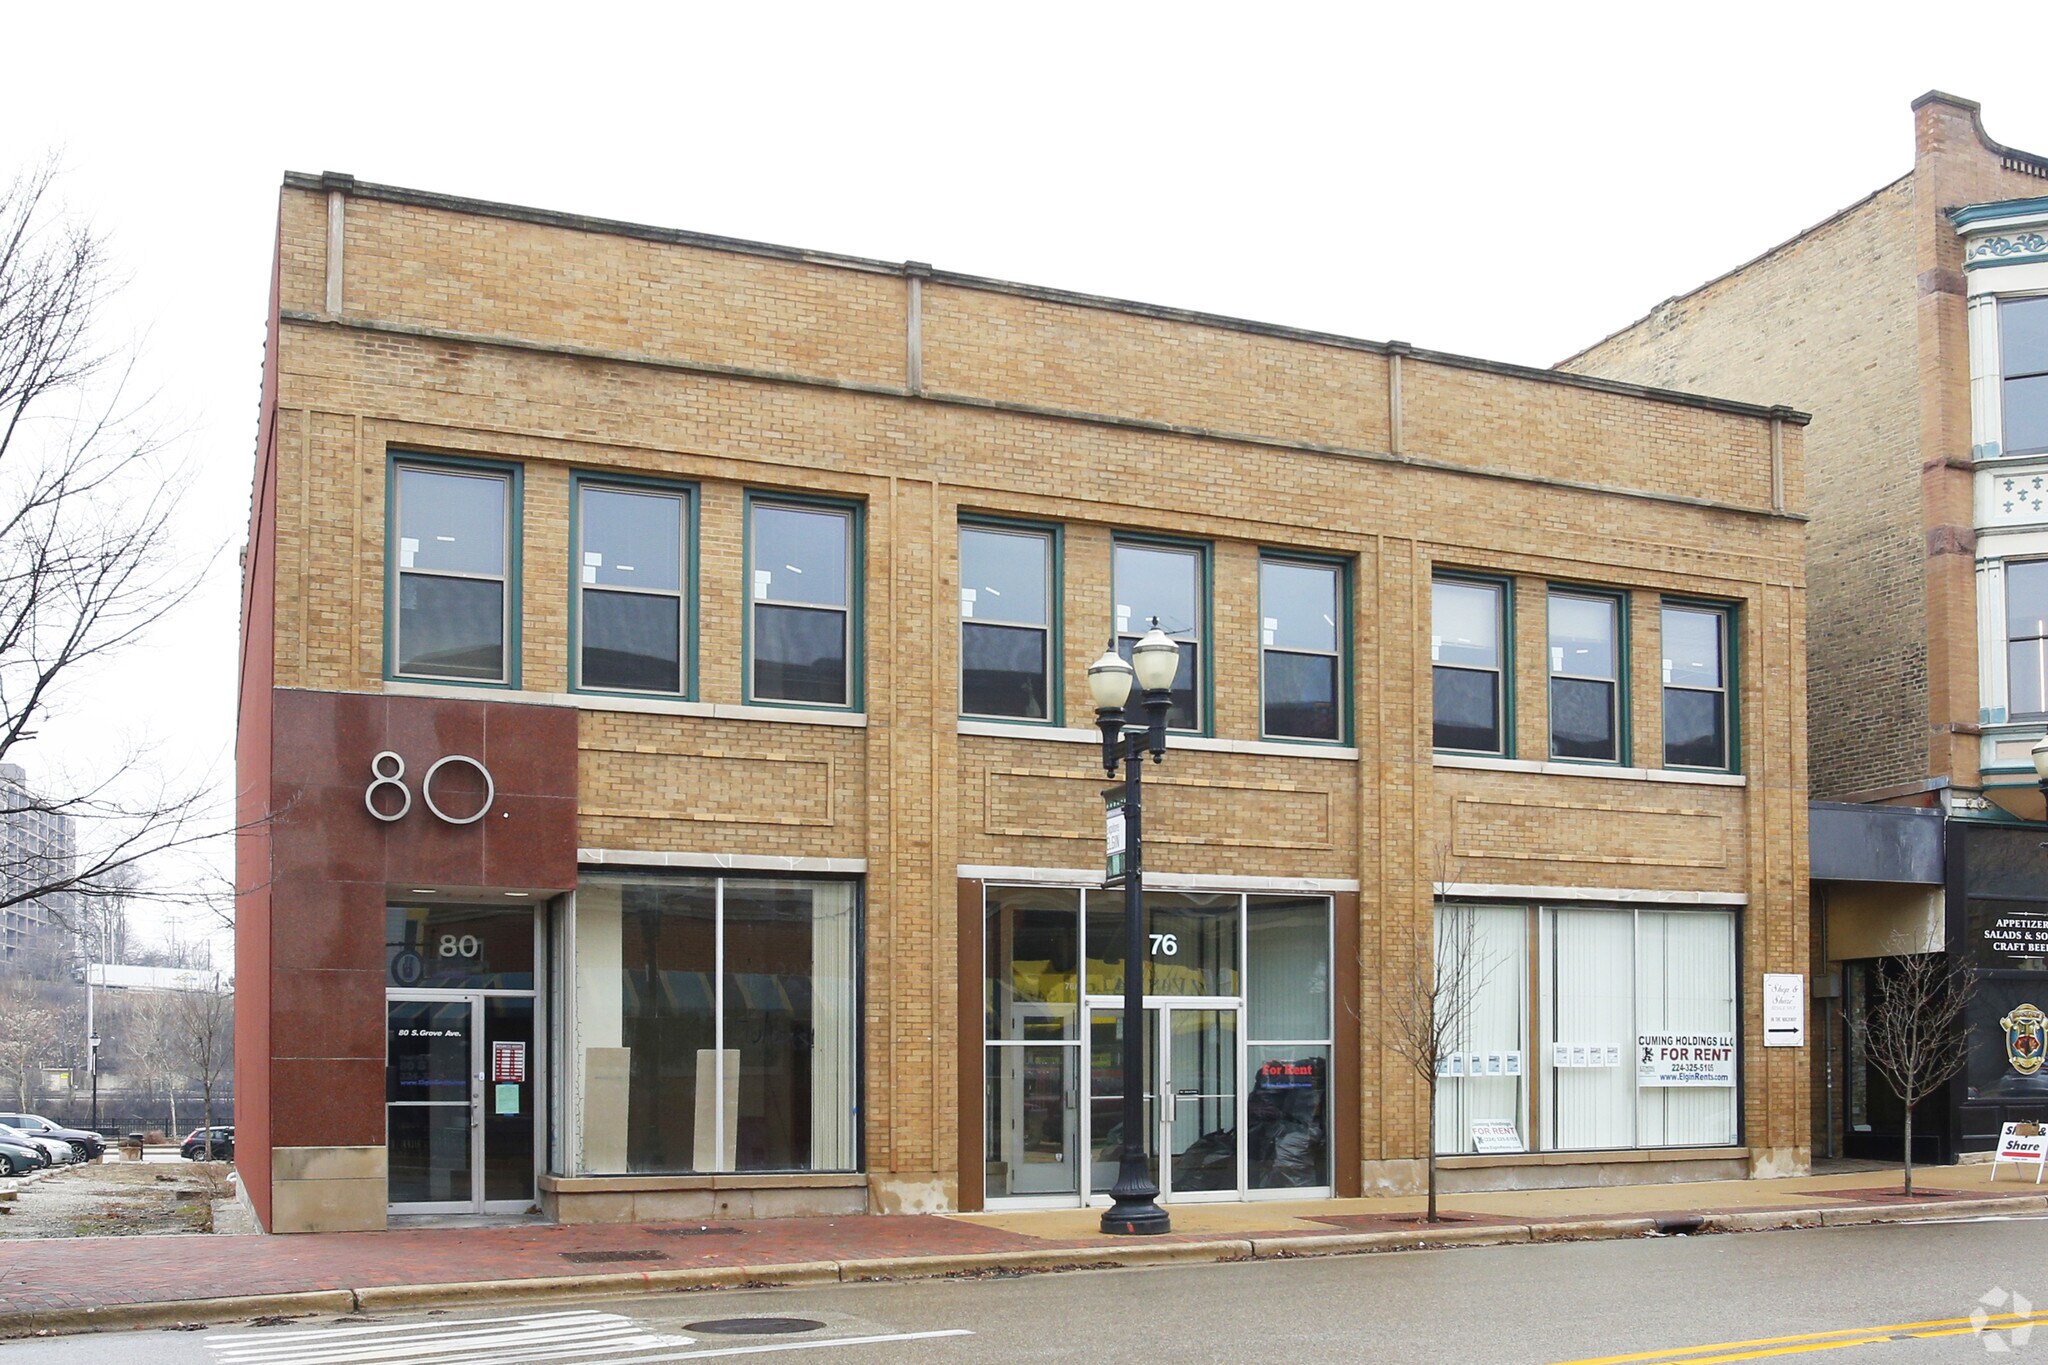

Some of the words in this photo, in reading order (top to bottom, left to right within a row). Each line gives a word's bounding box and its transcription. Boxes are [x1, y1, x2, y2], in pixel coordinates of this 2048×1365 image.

[365, 751, 495, 824] 80
[1984, 930, 2022, 940] SALADS
[2024, 931, 2033, 940] &
[439, 934, 478, 958] 80
[1149, 934, 1178, 956] 76
[1993, 942, 2026, 951] CRAFT
[2028, 943, 2048, 952] BEE
[419, 1029, 443, 1037] Grove
[1638, 1036, 1673, 1046] CUMING
[1675, 1036, 1717, 1046] HOLDINGS
[1661, 1048, 1689, 1061] FOR
[1694, 1048, 1731, 1061] RENT
[1262, 1064, 1282, 1075] For
[1284, 1064, 1313, 1075] Rent
[1660, 1073, 1728, 1082] www.ElginRents.com
[1472, 1127, 1491, 1135] FOR
[1492, 1127, 1515, 1135] RENT
[2005, 1140, 2040, 1151] Share
